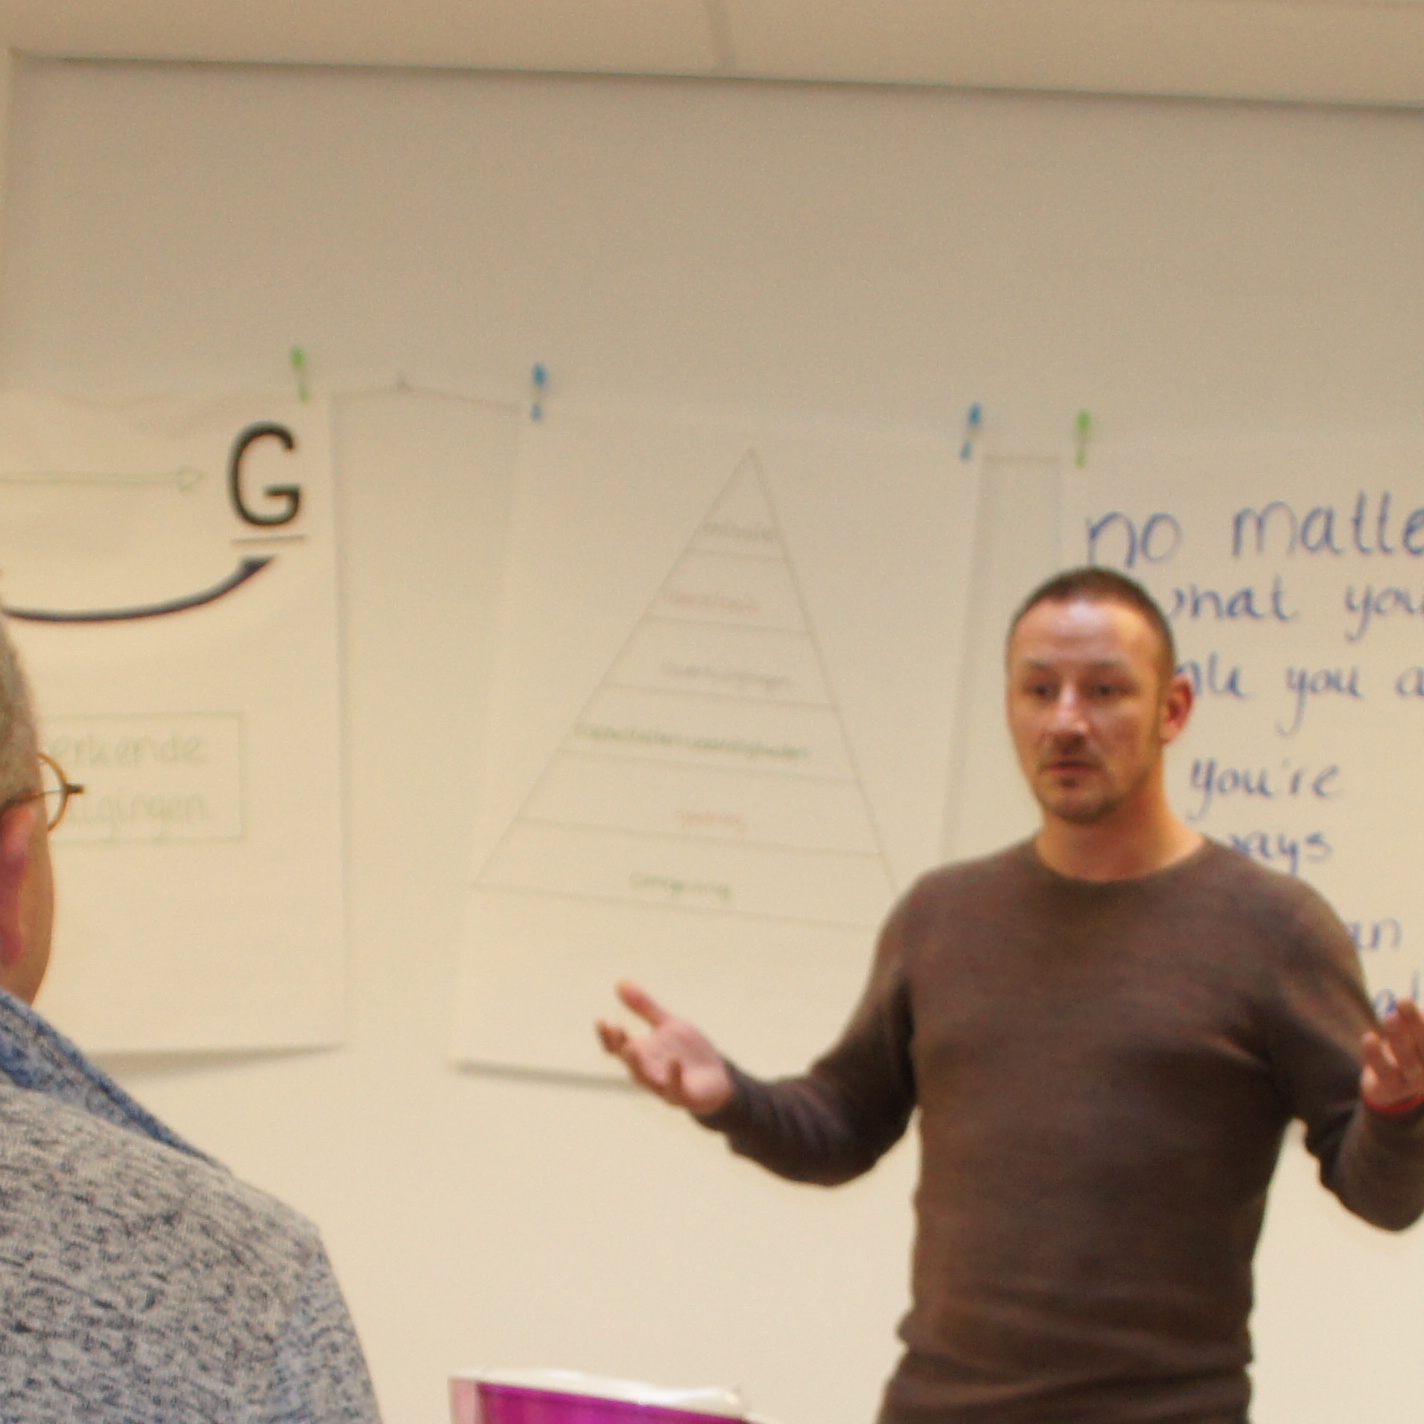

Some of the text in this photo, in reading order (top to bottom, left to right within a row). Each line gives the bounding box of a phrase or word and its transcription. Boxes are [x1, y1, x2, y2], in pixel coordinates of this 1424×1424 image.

[224, 420, 305, 527] G
[1085, 508, 1184, 568] no
[1276, 662, 1366, 737] you
[1186, 756, 1344, 822] you're
